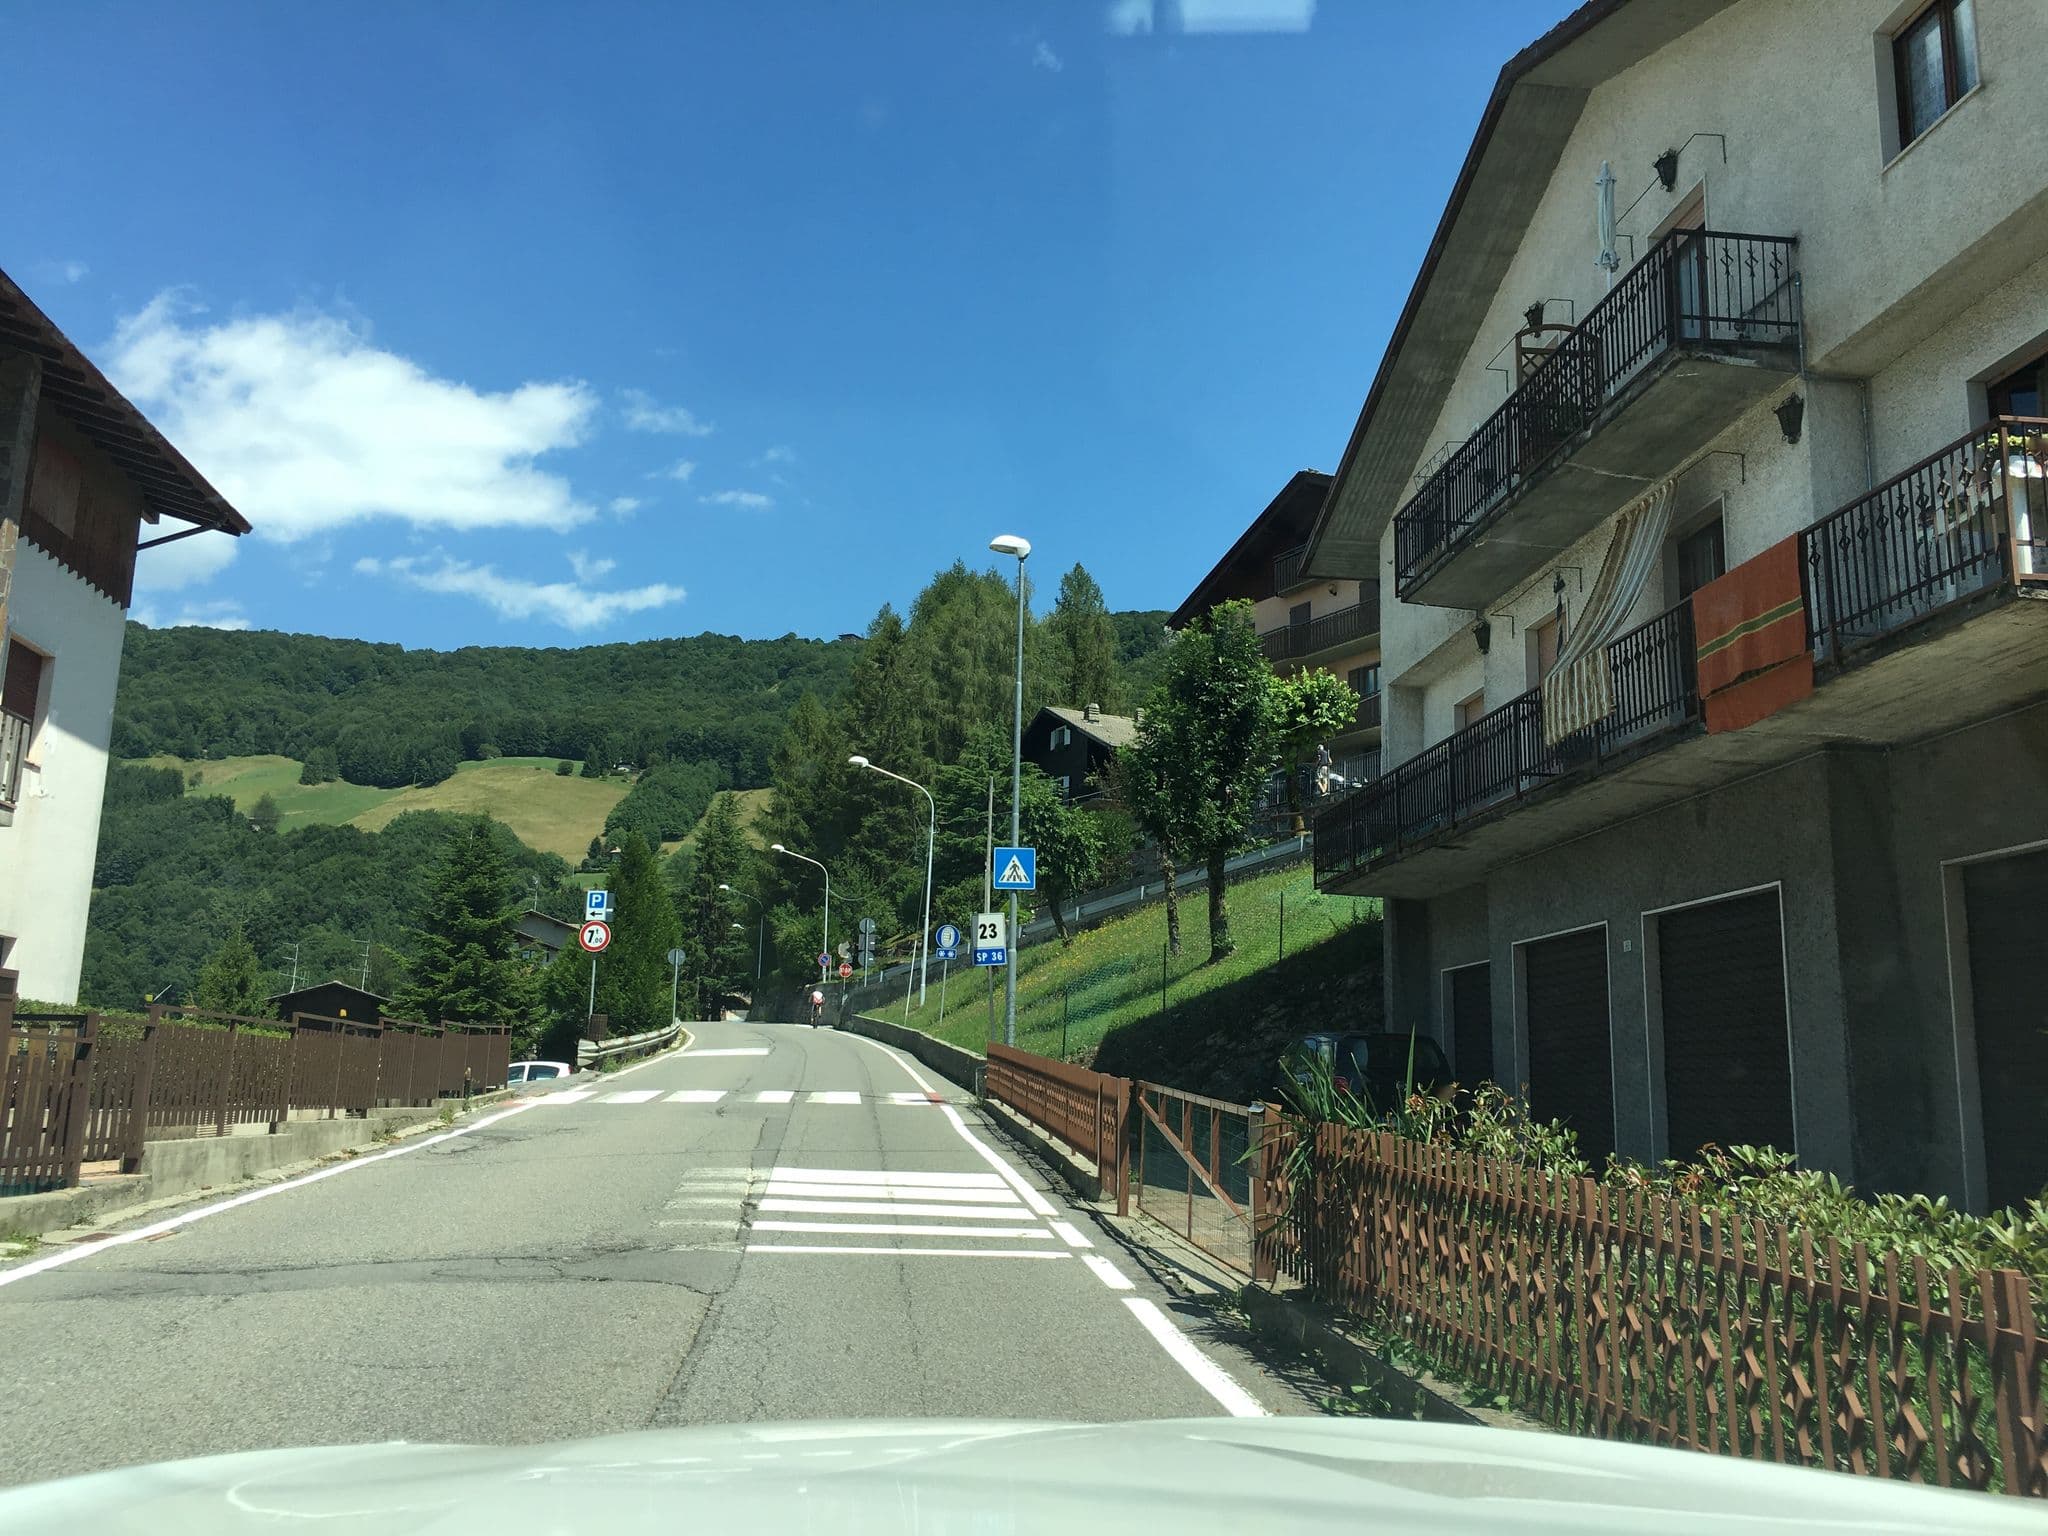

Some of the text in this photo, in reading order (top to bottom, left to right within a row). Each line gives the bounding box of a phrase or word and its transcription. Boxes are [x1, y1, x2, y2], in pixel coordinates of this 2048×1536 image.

[591, 894, 602, 907] P
[979, 923, 997, 939] 23
[976, 951, 1003, 962] SP 36
